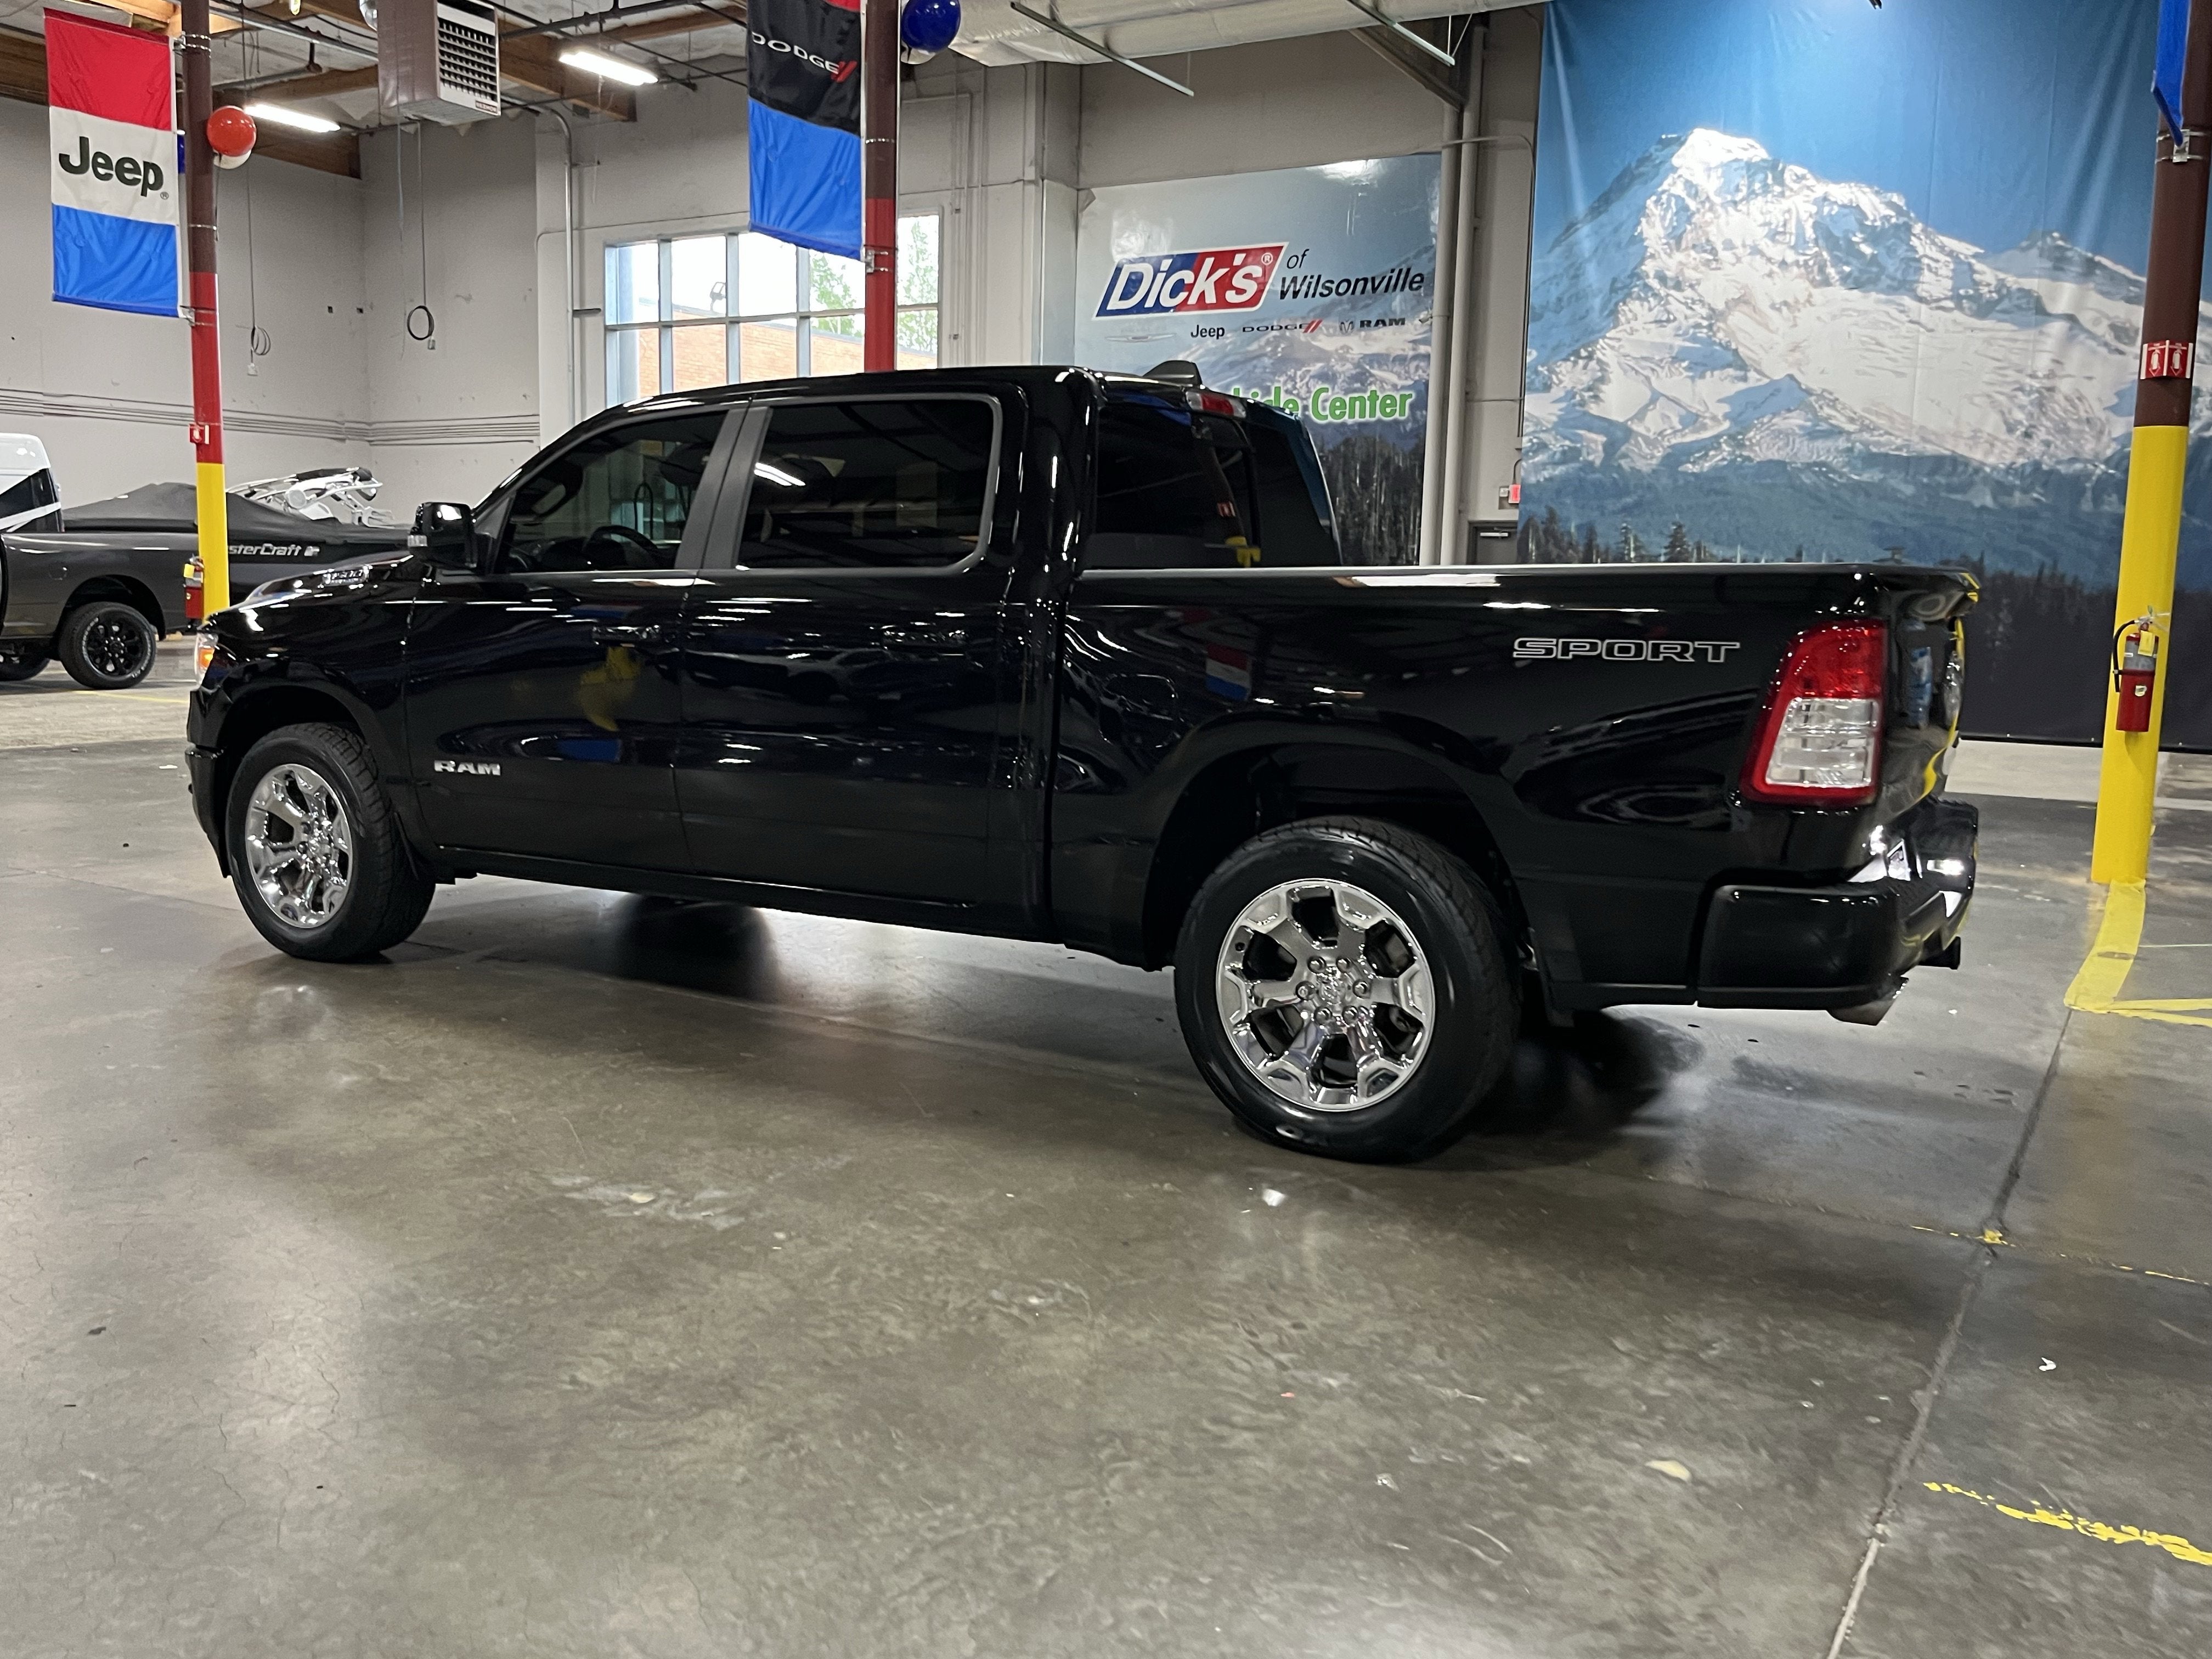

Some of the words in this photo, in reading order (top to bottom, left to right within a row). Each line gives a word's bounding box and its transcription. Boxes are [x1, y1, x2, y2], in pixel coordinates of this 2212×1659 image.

[752, 31, 839, 75] DODGE
[58, 136, 163, 198] Jeep
[1286, 249, 1310, 269] of
[1106, 253, 1263, 311] Dick's
[1279, 267, 1425, 300] Wilsonville
[1190, 324, 1225, 340] Jeep
[1359, 318, 1406, 328] RAM
[1312, 387, 1413, 421] Center
[1513, 637, 1741, 663] SPORT
[434, 759, 501, 776] RAM
